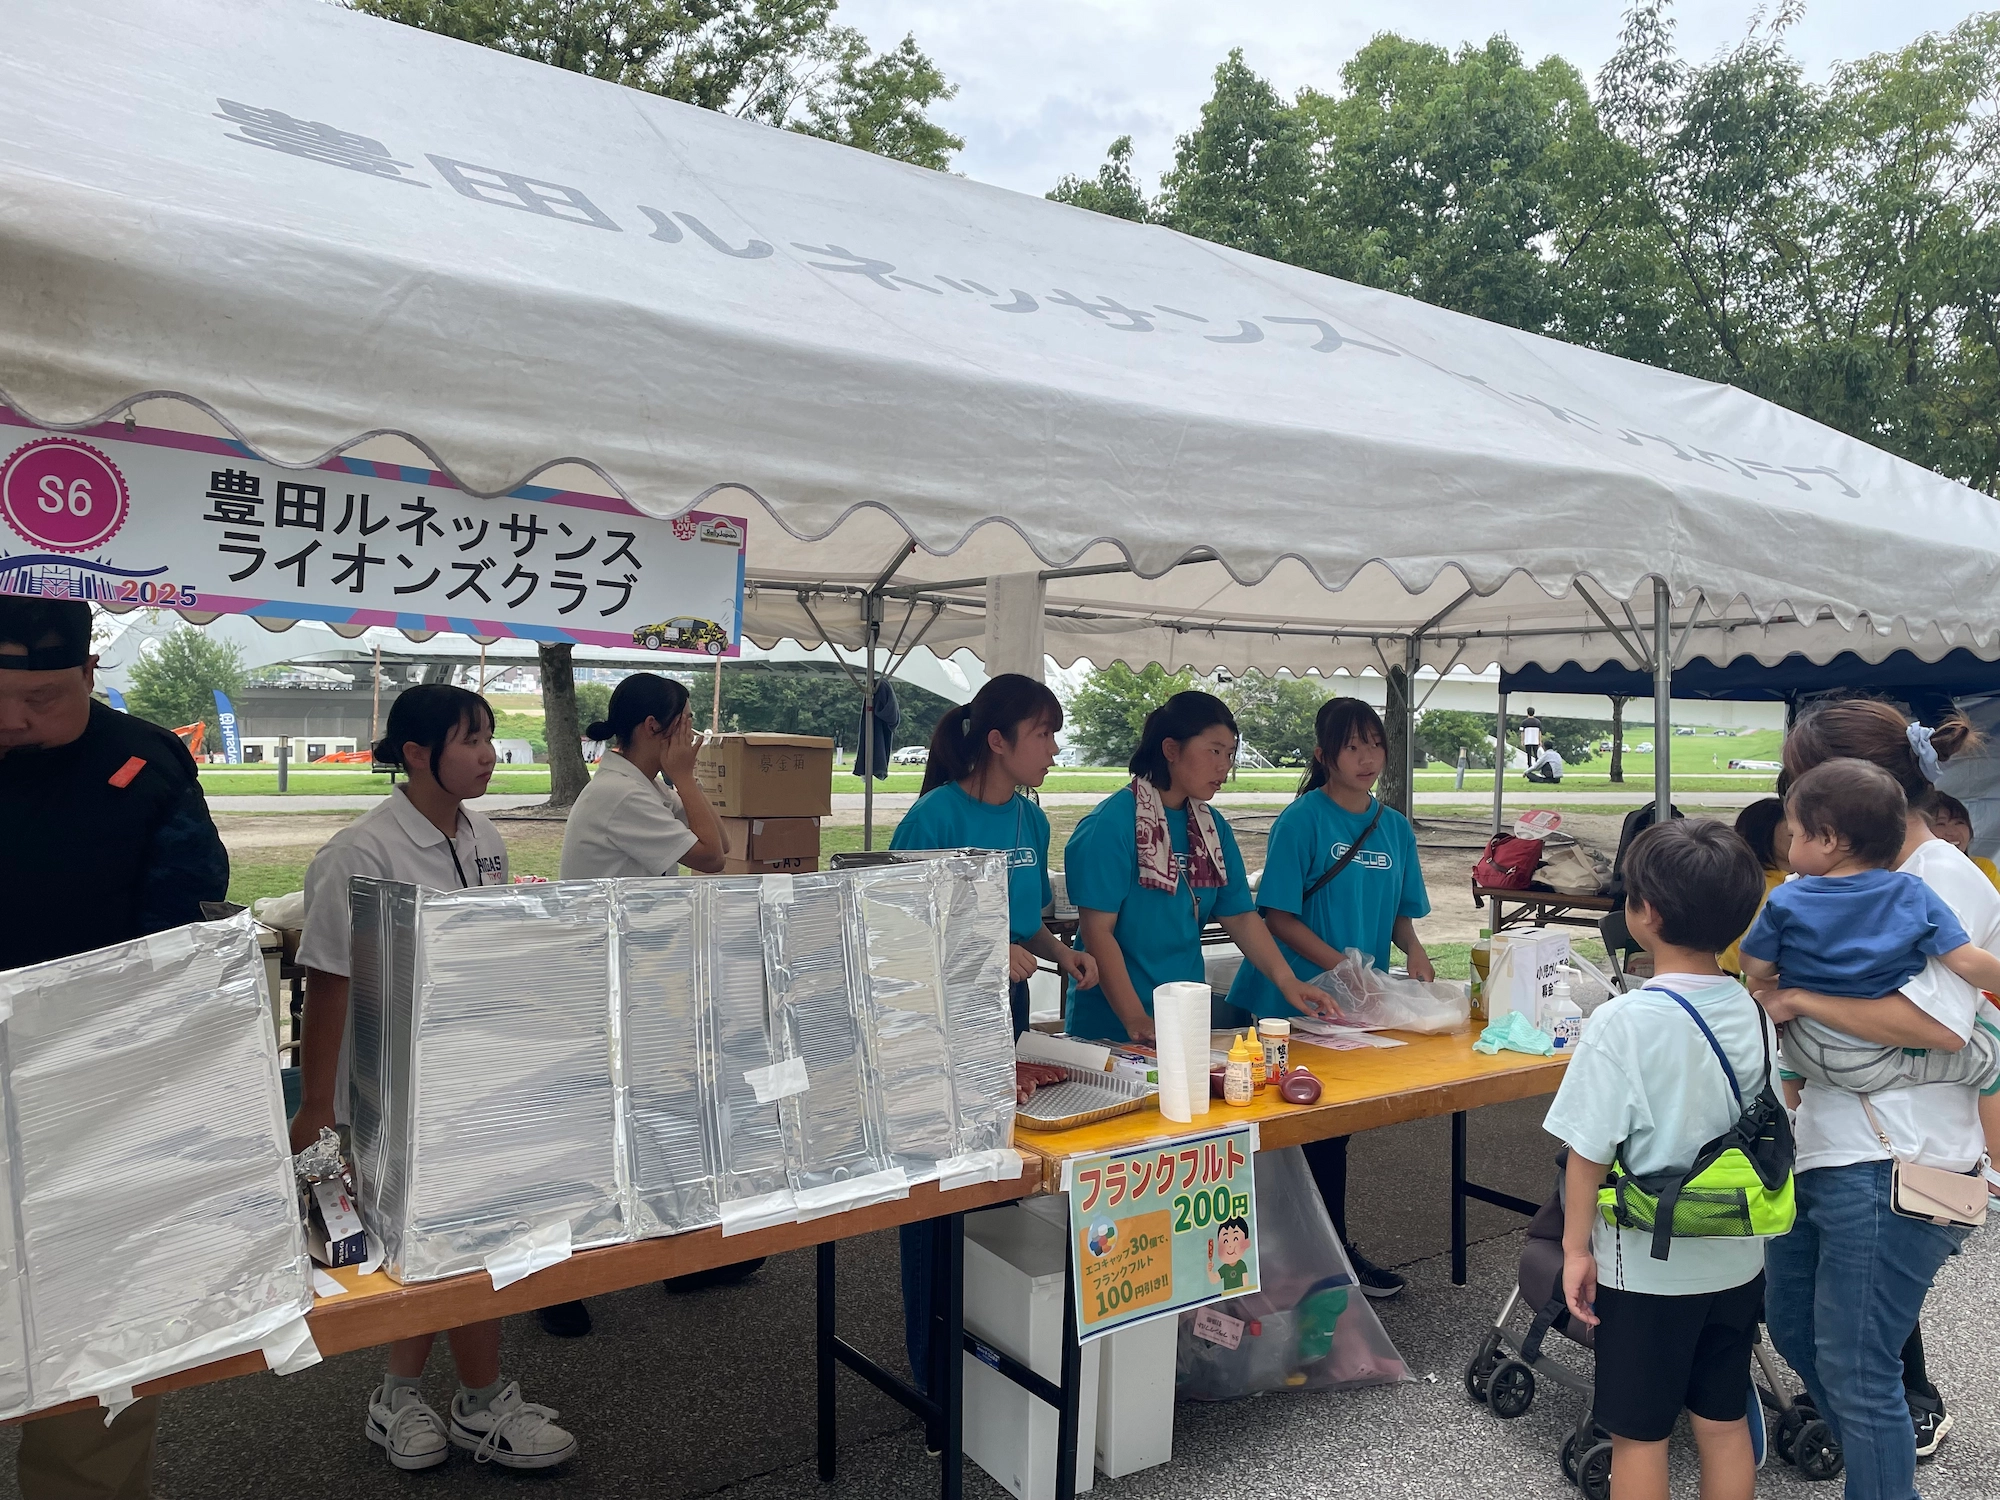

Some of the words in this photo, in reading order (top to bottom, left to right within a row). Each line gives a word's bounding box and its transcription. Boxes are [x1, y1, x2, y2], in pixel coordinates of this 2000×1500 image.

[37, 474, 93, 519] S6
[203, 468, 644, 571] 豊田ルネッサンス
[672, 522, 697, 532] LOVE
[120, 579, 197, 607] 2025
[218, 532, 639, 618] ライオンズクラブ
[1079, 1139, 1245, 1213] フランクフルト
[1173, 1185, 1249, 1233] 200円
[1093, 1255, 1154, 1290] フランクフルト
